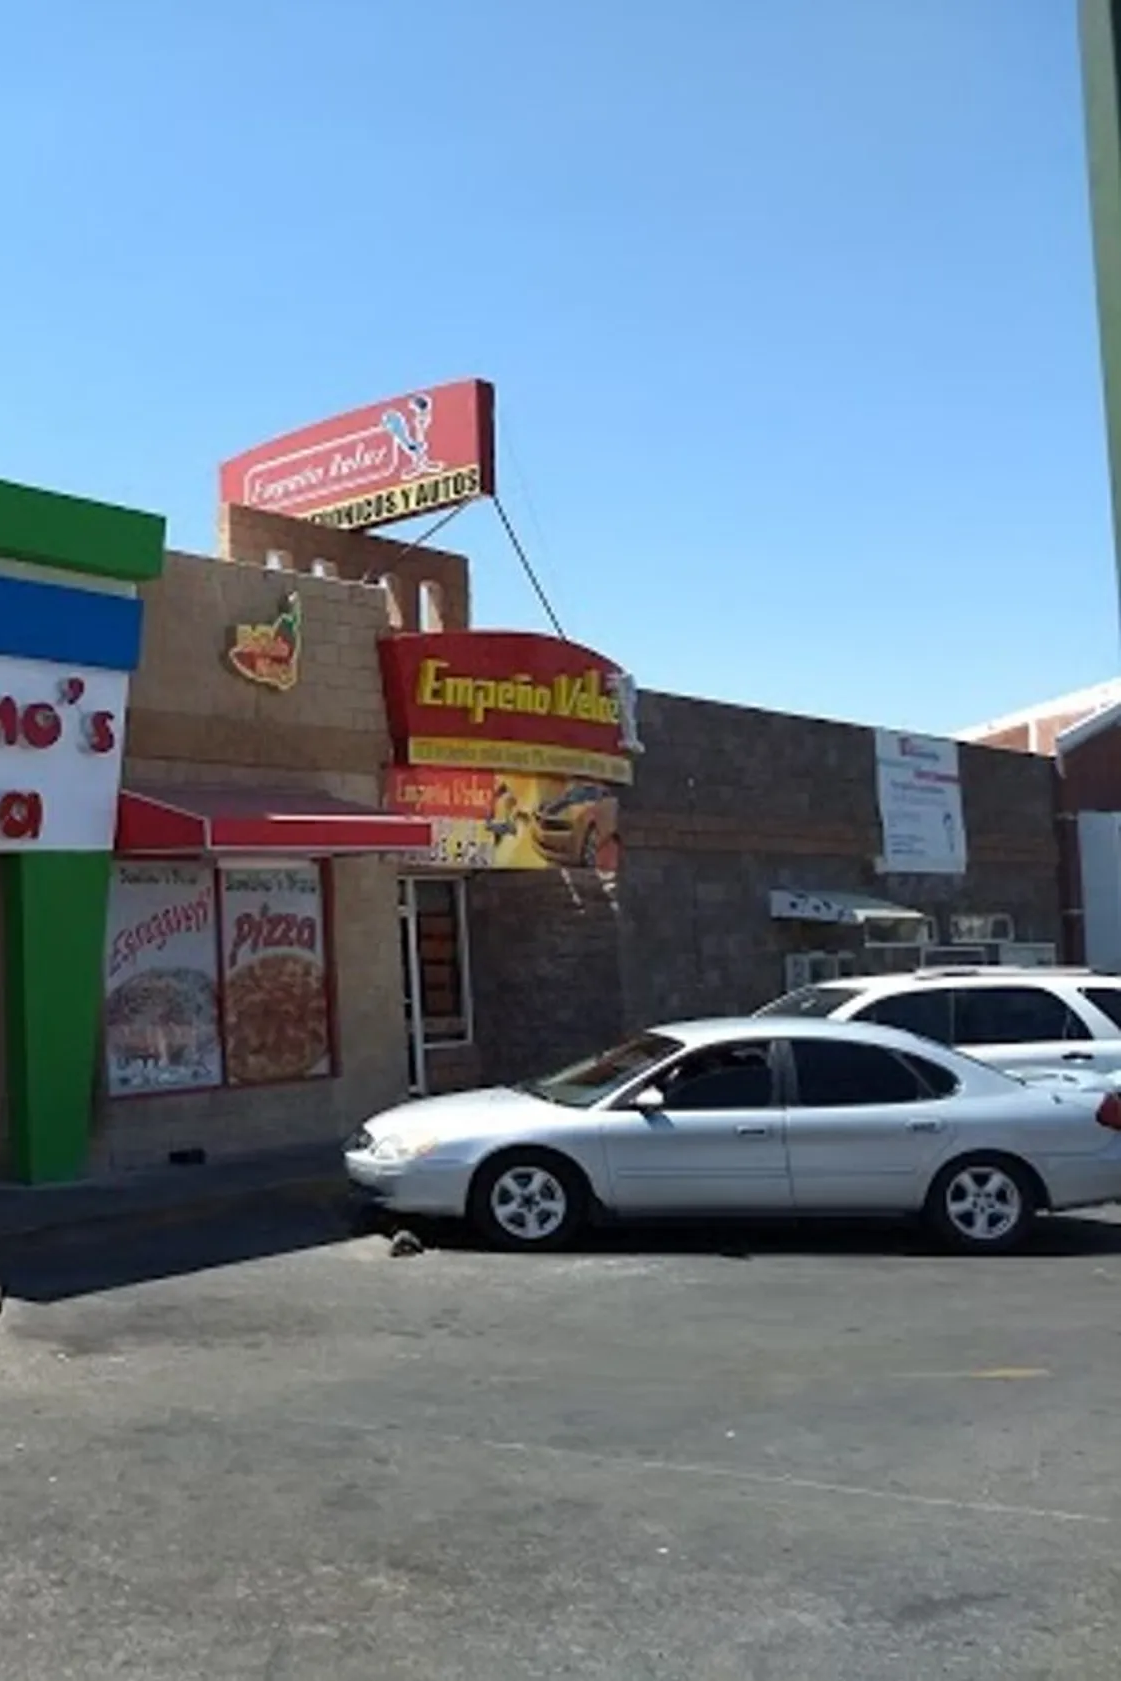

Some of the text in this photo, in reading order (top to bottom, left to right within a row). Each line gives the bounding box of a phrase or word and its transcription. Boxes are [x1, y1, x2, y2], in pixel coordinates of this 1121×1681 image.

[415, 468, 479, 507] AUTOS
[417, 658, 620, 724] Empeño Velo
